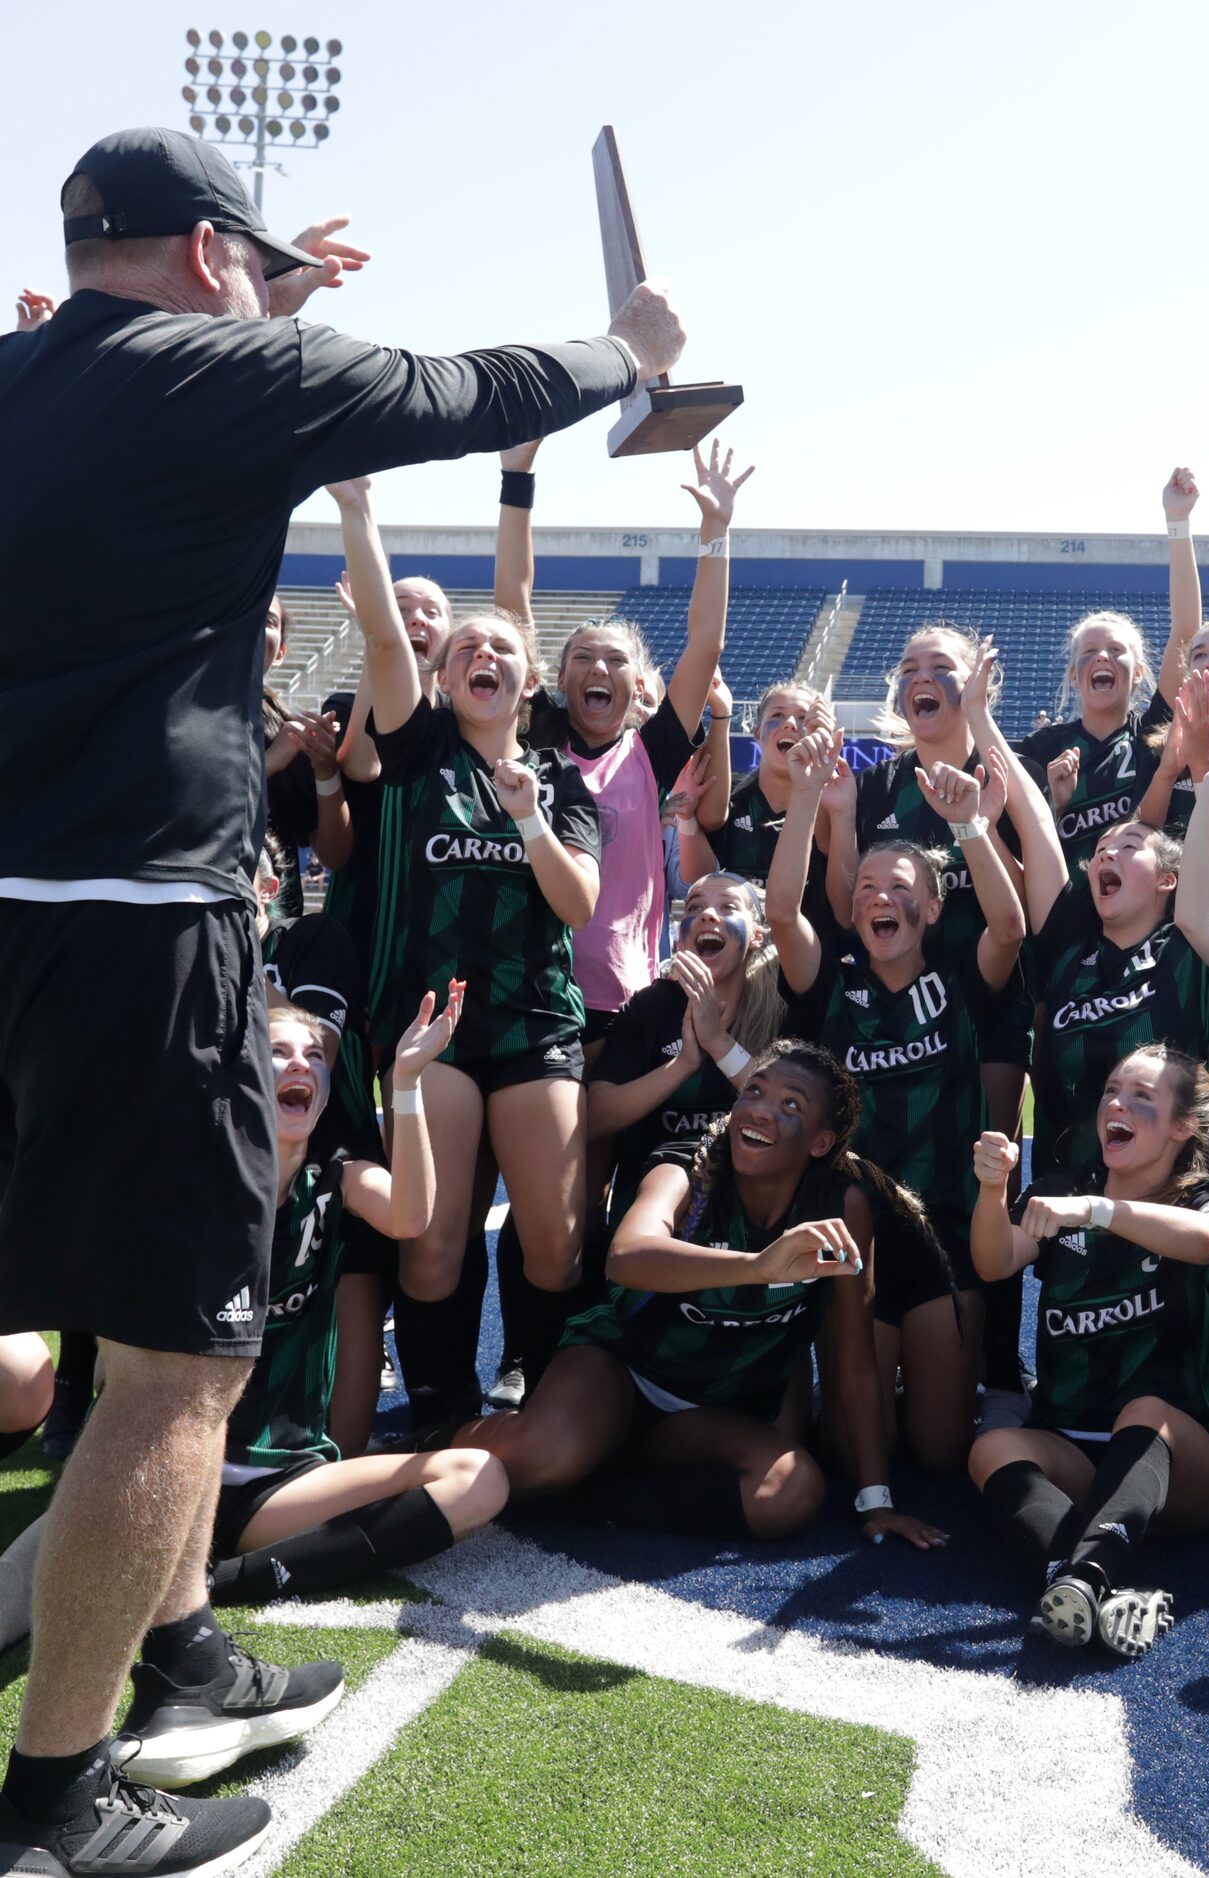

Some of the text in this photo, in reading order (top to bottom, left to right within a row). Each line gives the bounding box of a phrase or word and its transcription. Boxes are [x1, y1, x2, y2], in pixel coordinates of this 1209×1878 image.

[622, 534, 648, 548] 215
[1060, 540, 1086, 553] 214
[424, 833, 531, 864] CARRO
[844, 990, 870, 1008] adidas
[908, 971, 948, 1025] 10
[1053, 981, 1156, 1030] CARROLL
[845, 1030, 948, 1073] CARROLL
[1059, 1237, 1088, 1256] adidas
[216, 1308, 254, 1322] adidas
[1045, 1288, 1165, 1338] CARROLL
